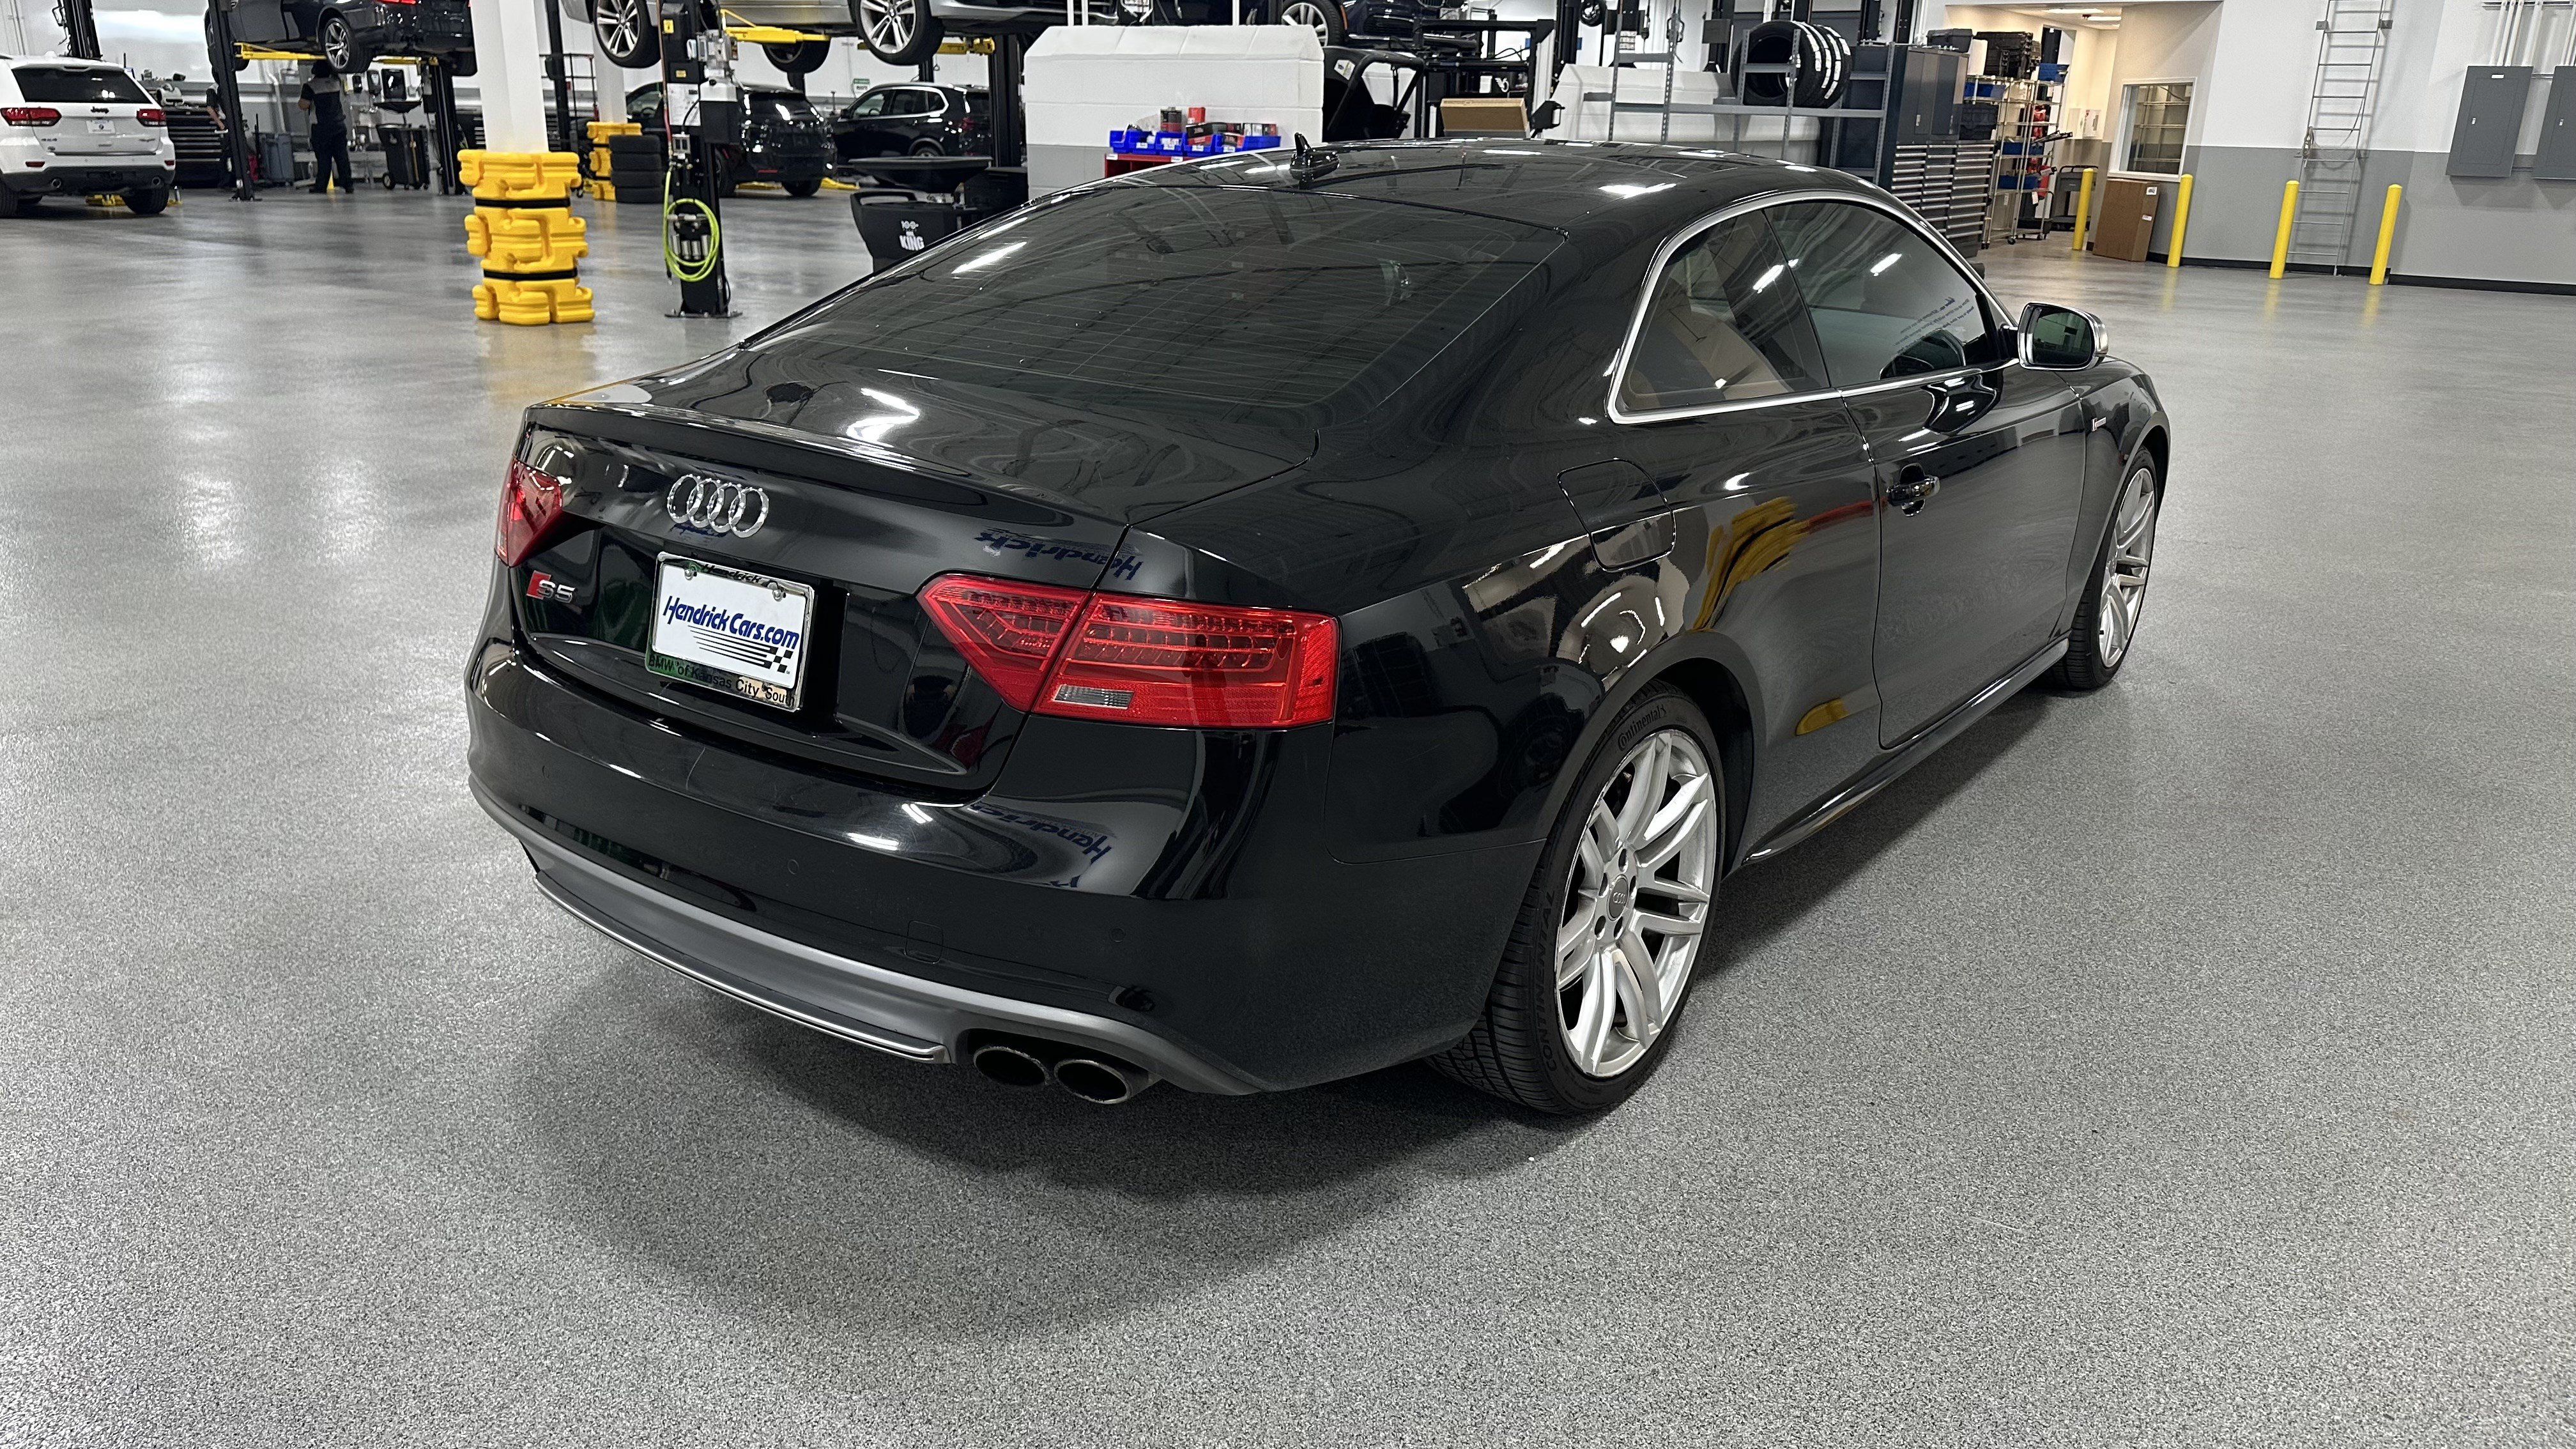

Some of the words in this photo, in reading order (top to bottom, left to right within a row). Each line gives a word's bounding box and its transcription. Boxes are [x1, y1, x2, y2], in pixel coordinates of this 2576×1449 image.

[900, 234, 924, 251] KING
[538, 579, 576, 603] S5
[648, 654, 673, 669] BMW
[678, 663, 691, 676] of
[690, 665, 732, 689] Kansas
[735, 678, 760, 698] City
[765, 687, 795, 706] South
[1618, 706, 1661, 751] Continental
